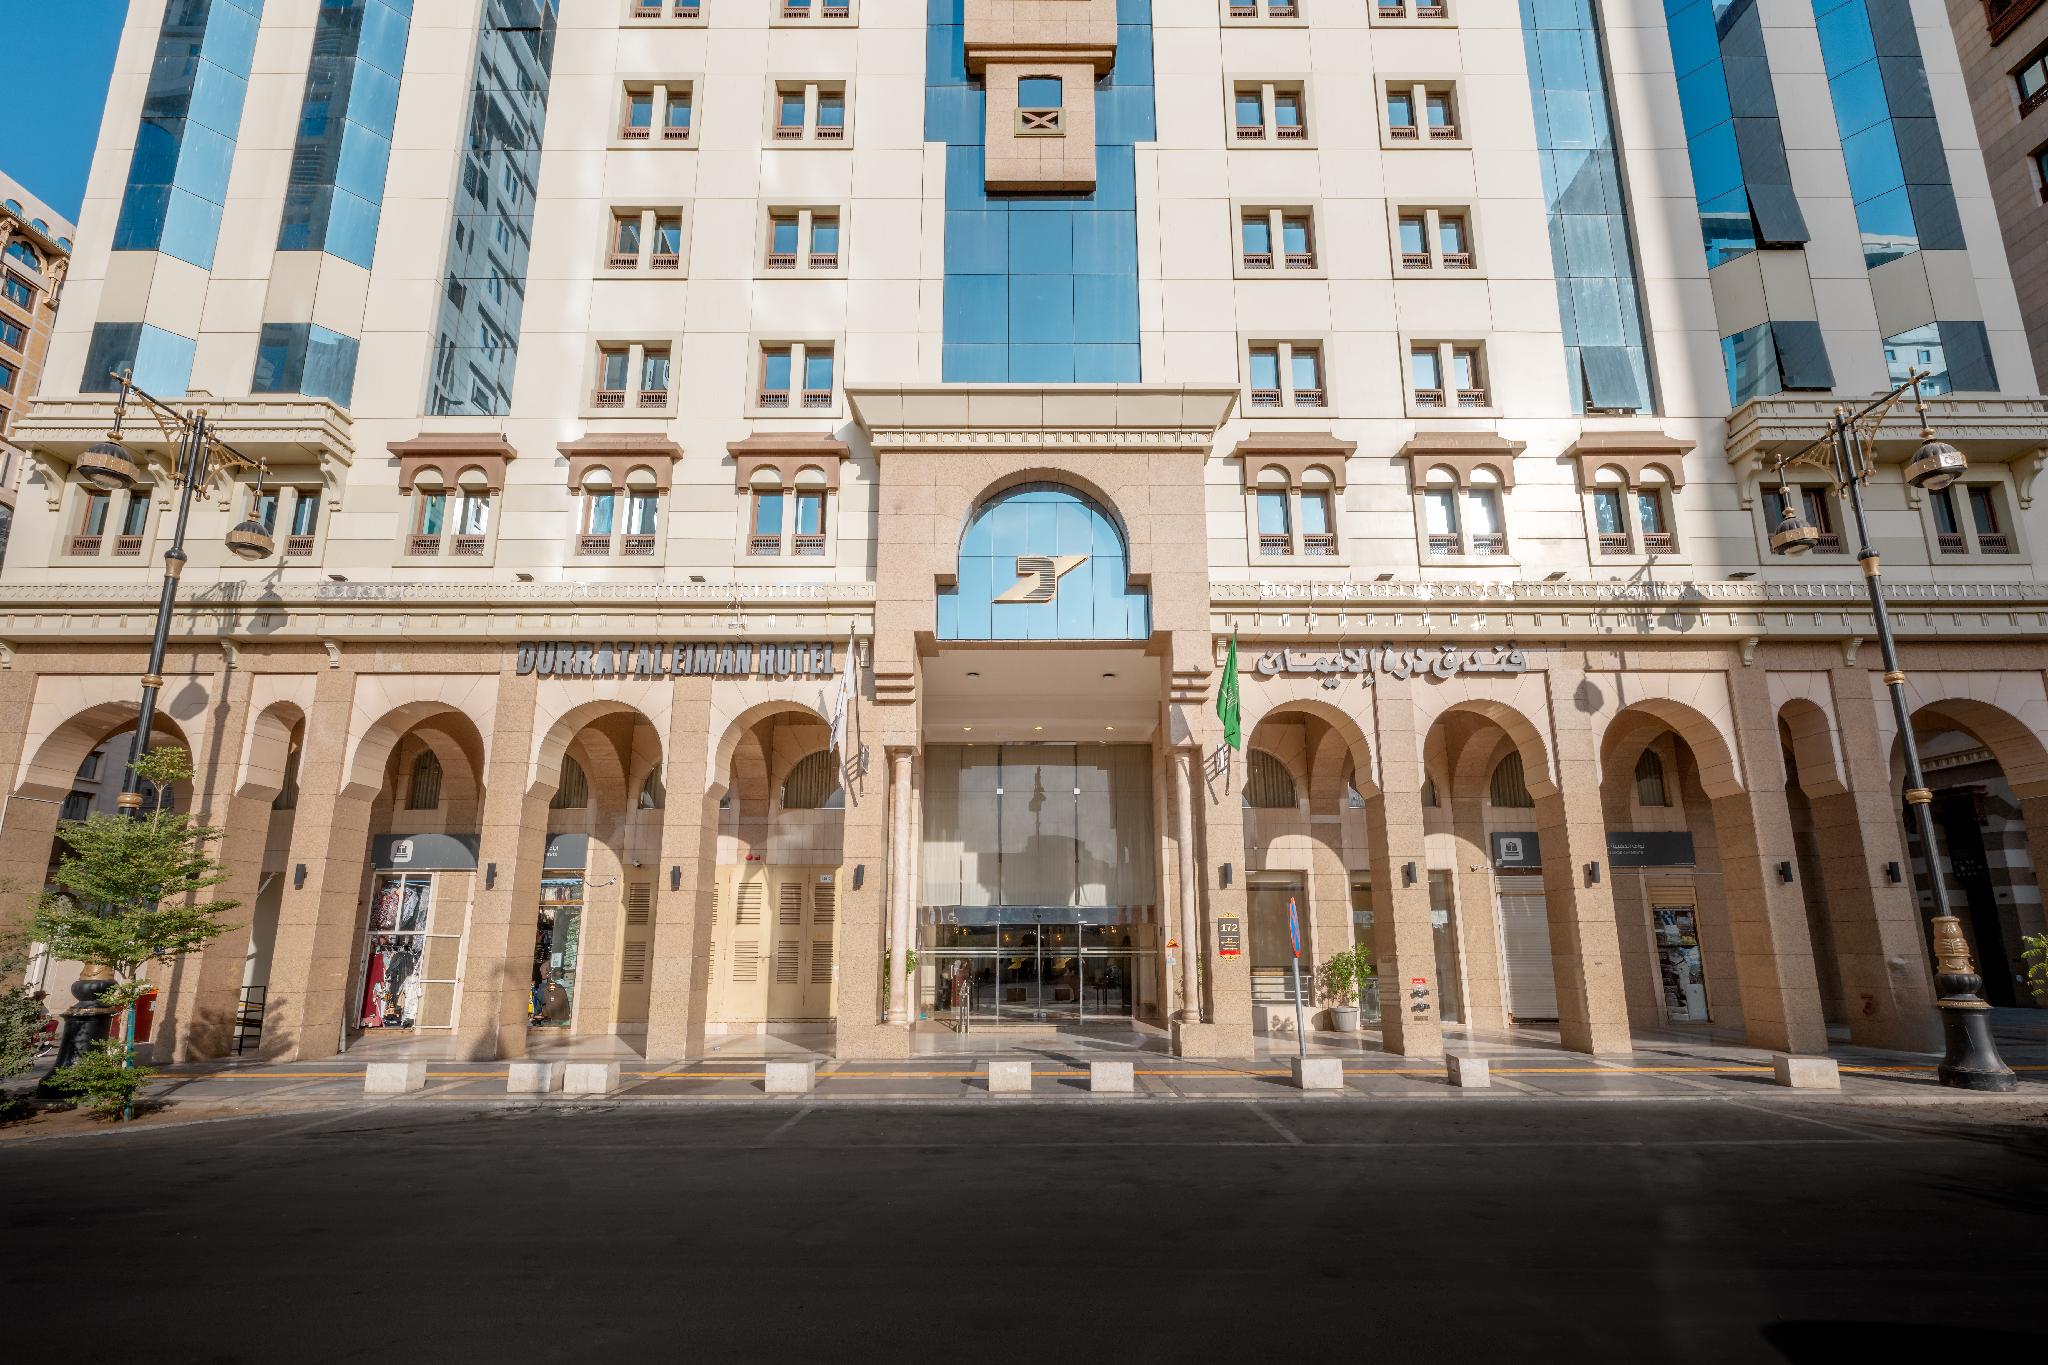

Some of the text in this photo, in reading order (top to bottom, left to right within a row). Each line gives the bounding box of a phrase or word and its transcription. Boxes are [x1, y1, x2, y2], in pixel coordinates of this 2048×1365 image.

[516, 641, 835, 676] DURRAT AL EIMAN HOTEL
[1432, 640, 1526, 680] فندق
[1220, 923, 1238, 932] 172
